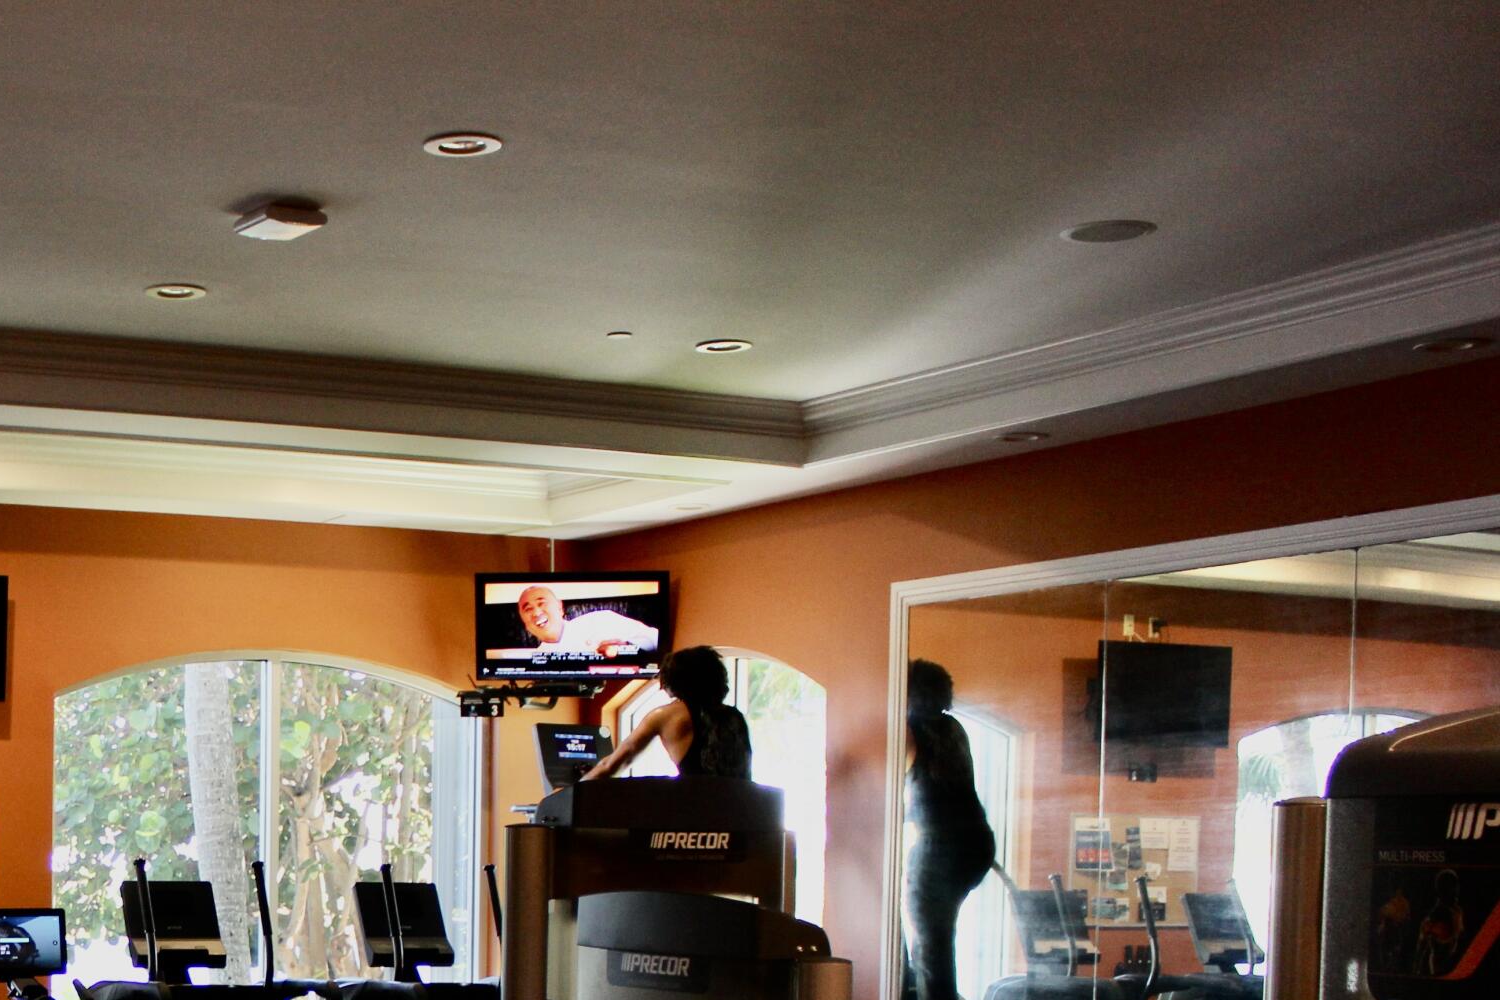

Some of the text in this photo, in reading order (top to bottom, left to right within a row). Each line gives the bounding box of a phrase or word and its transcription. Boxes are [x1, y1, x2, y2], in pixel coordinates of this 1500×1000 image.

[491, 705, 498, 716] 3
[661, 831, 731, 849] PRECOR
[629, 953, 691, 977] PRECOR
